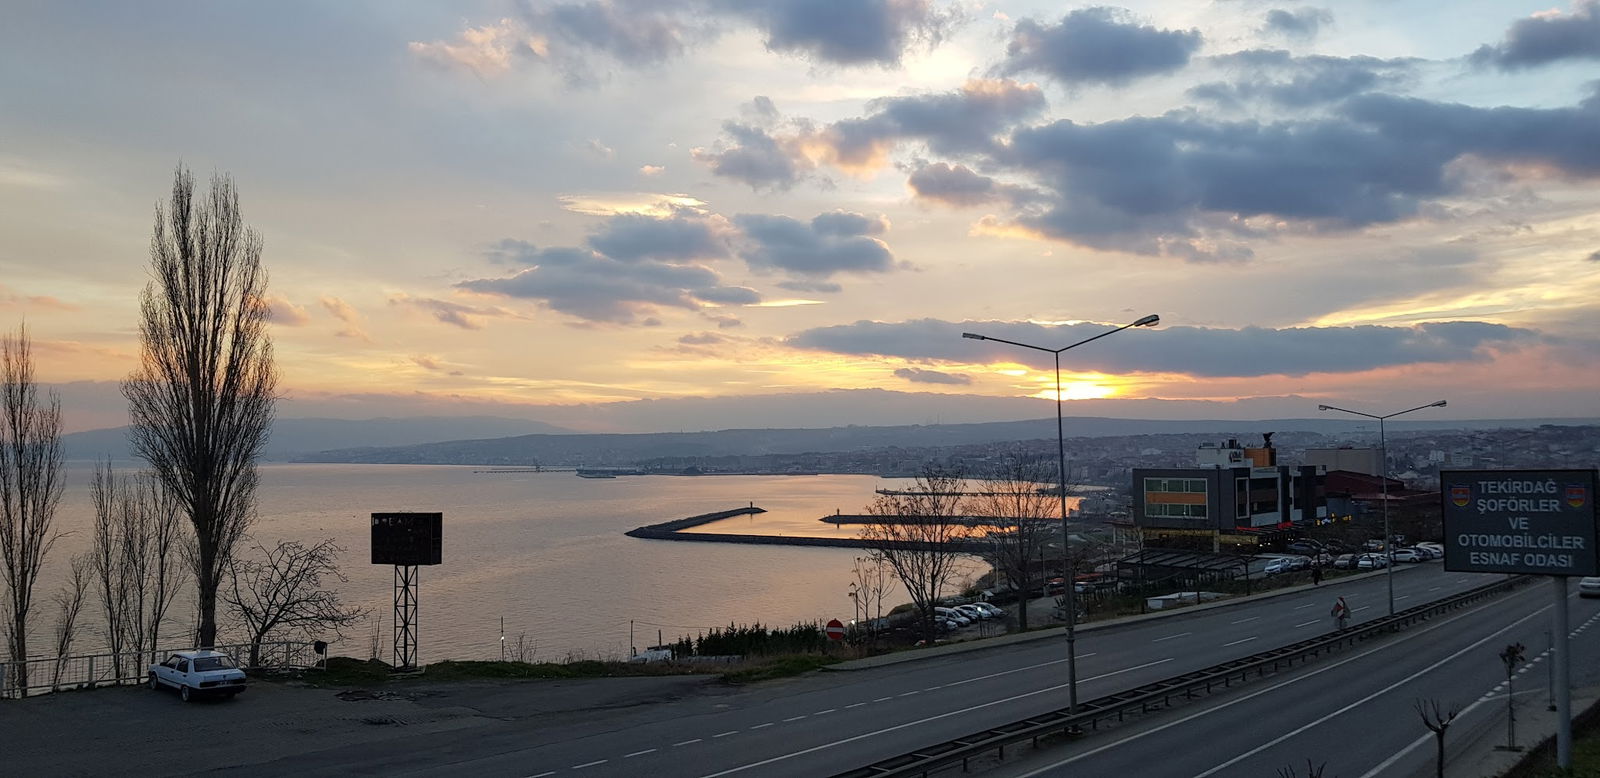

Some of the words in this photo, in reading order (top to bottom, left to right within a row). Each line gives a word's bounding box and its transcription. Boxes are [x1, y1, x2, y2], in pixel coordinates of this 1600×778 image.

[1478, 479, 1557, 494] TEKİRDAĞ
[1477, 496, 1561, 514] ŞOFÖRLER
[1508, 517, 1529, 529] VE
[1458, 532, 1584, 549] OTOMOBİLCİLER
[1470, 552, 1520, 565] ESNAF
[1524, 553, 1572, 567] ODASI
